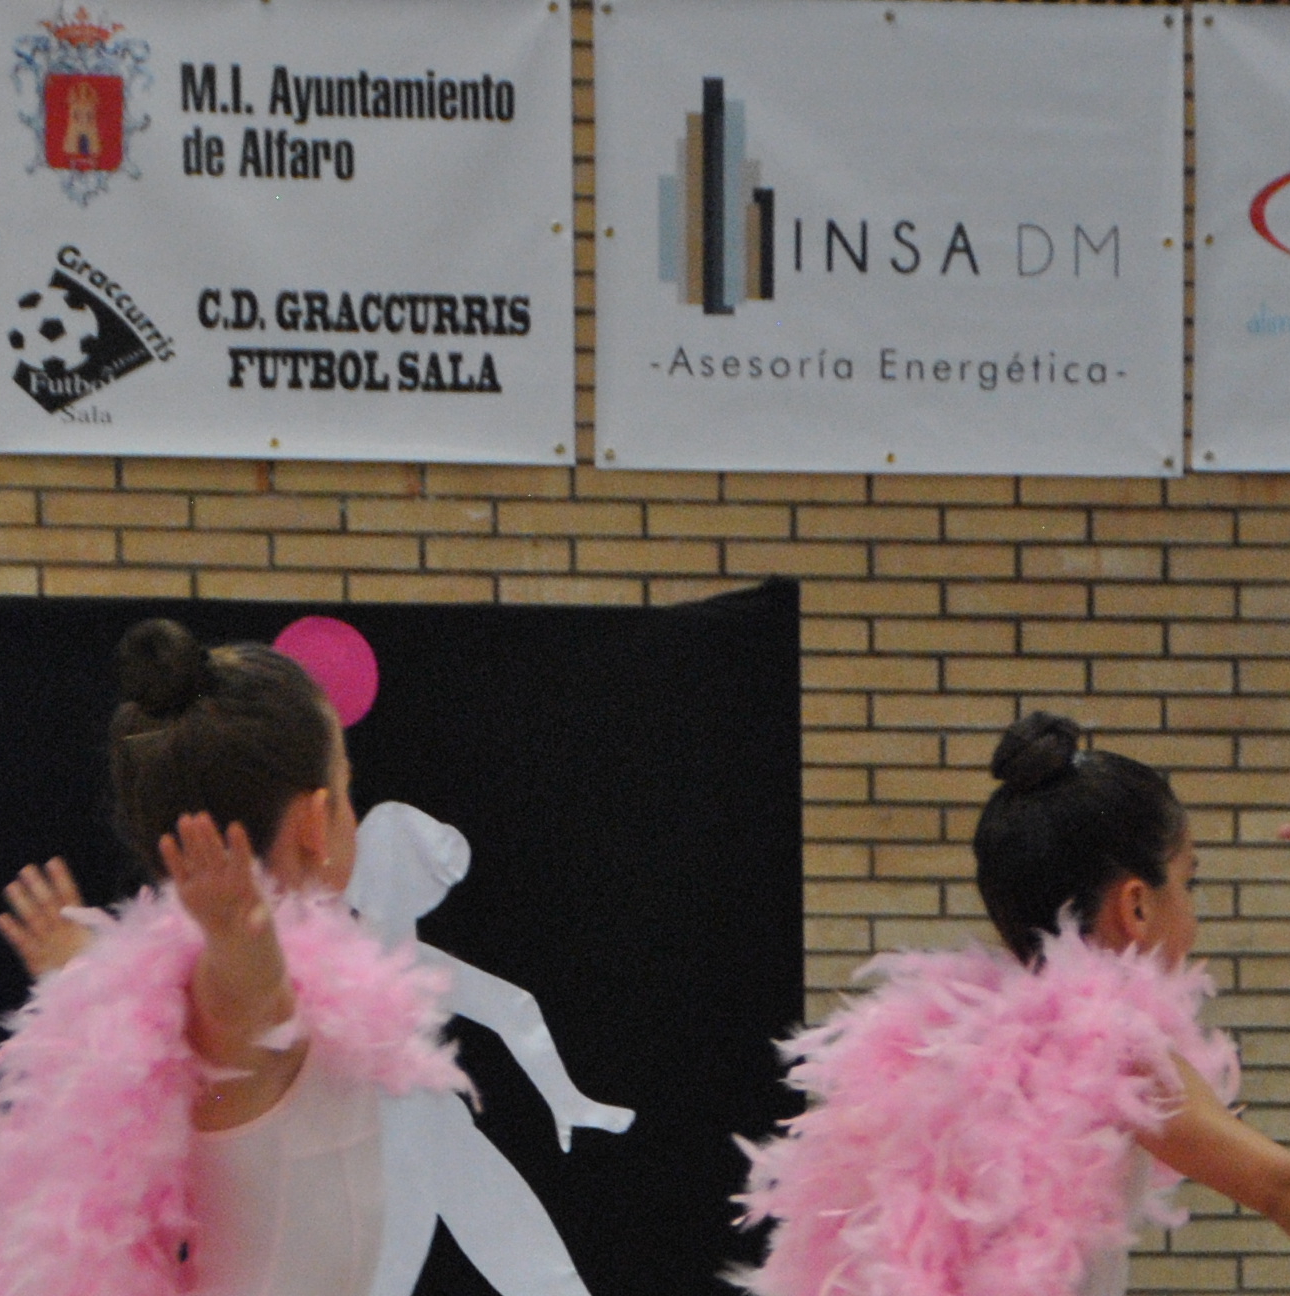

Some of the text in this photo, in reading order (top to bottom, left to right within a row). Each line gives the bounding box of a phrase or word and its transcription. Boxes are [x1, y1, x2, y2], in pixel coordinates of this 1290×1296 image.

[180, 62, 516, 124] M.I. Ayuntamiento
[183, 128, 355, 180] de Alfaro
[793, 218, 1121, 279] INSA DM
[57, 245, 176, 364] Graccurris
[197, 289, 532, 337] C.D. GRACCURRIS
[228, 348, 502, 394] FUTBOL SALA
[61, 403, 113, 424] Sala
